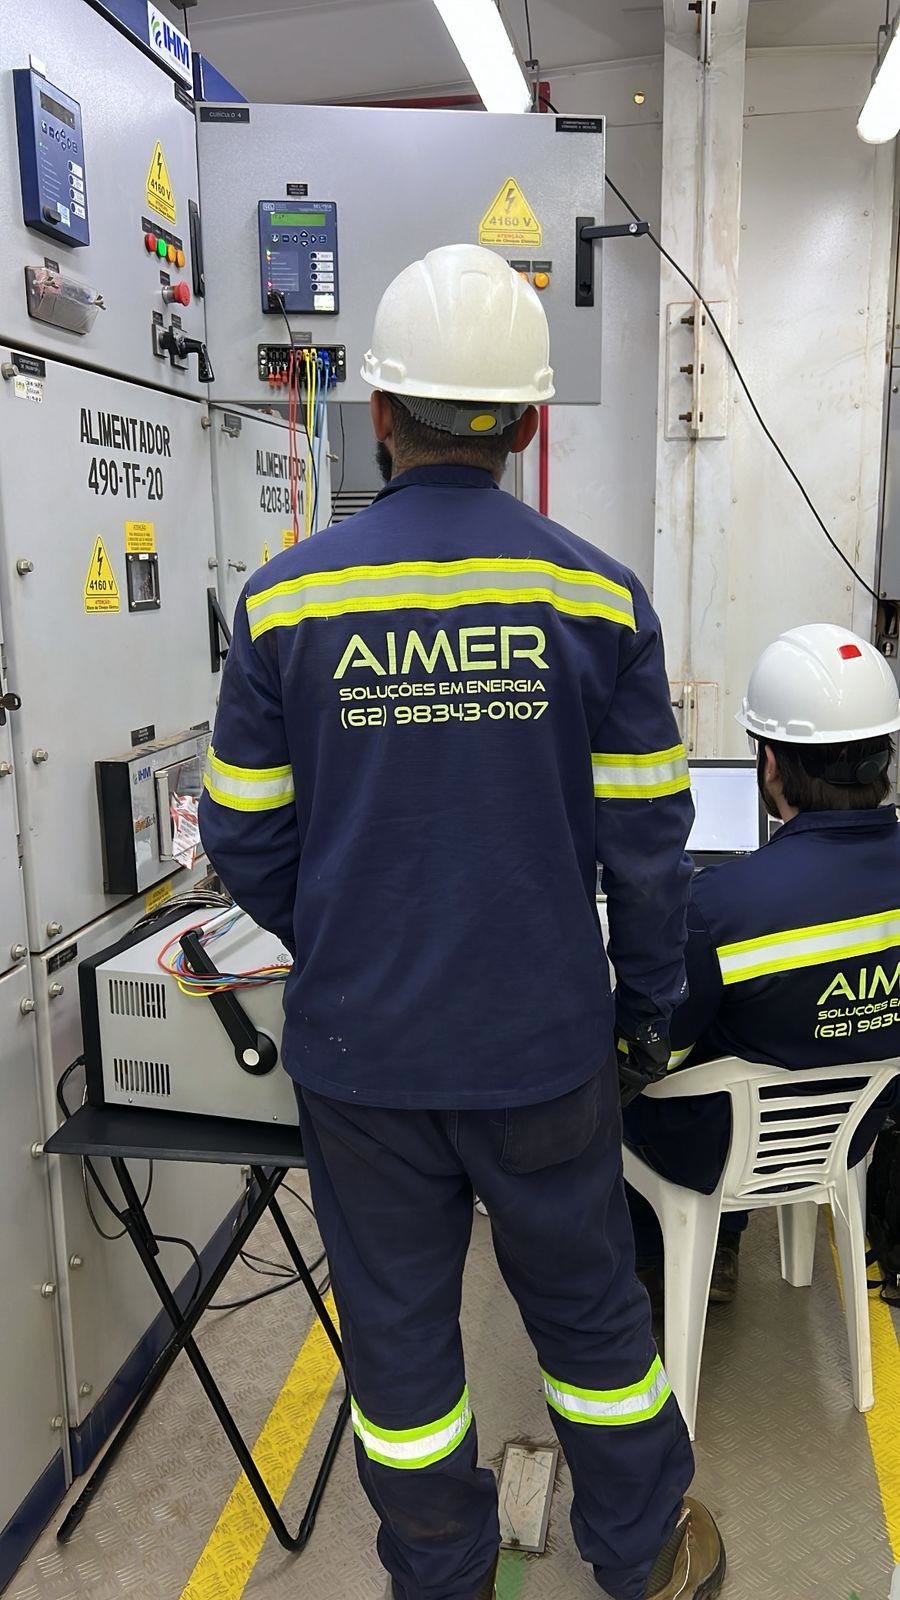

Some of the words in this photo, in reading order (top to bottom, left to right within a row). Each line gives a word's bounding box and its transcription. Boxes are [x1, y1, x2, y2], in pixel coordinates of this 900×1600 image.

[163, 21, 190, 70] IHM
[489, 217, 519, 226] 4160
[523, 217, 531, 226] V
[80, 408, 172, 457] ALIMENTADOR
[90, 580, 106, 590] 4160
[108, 580, 113, 590] V
[333, 626, 549, 679] AIMER
[339, 682, 436, 701] SOLUÇÕES
[439, 682, 464, 695] EM
[467, 680, 546, 694] ENERGIA
[340, 705, 387, 730] (62)
[394, 701, 549, 724] 98343-0107
[137, 766, 151, 781] IHM
[817, 962, 900, 1006] AIM
[818, 1001, 888, 1020] SOLUÇÕES
[890, 998, 900, 1008] E
[815, 1019, 852, 1039] (62)
